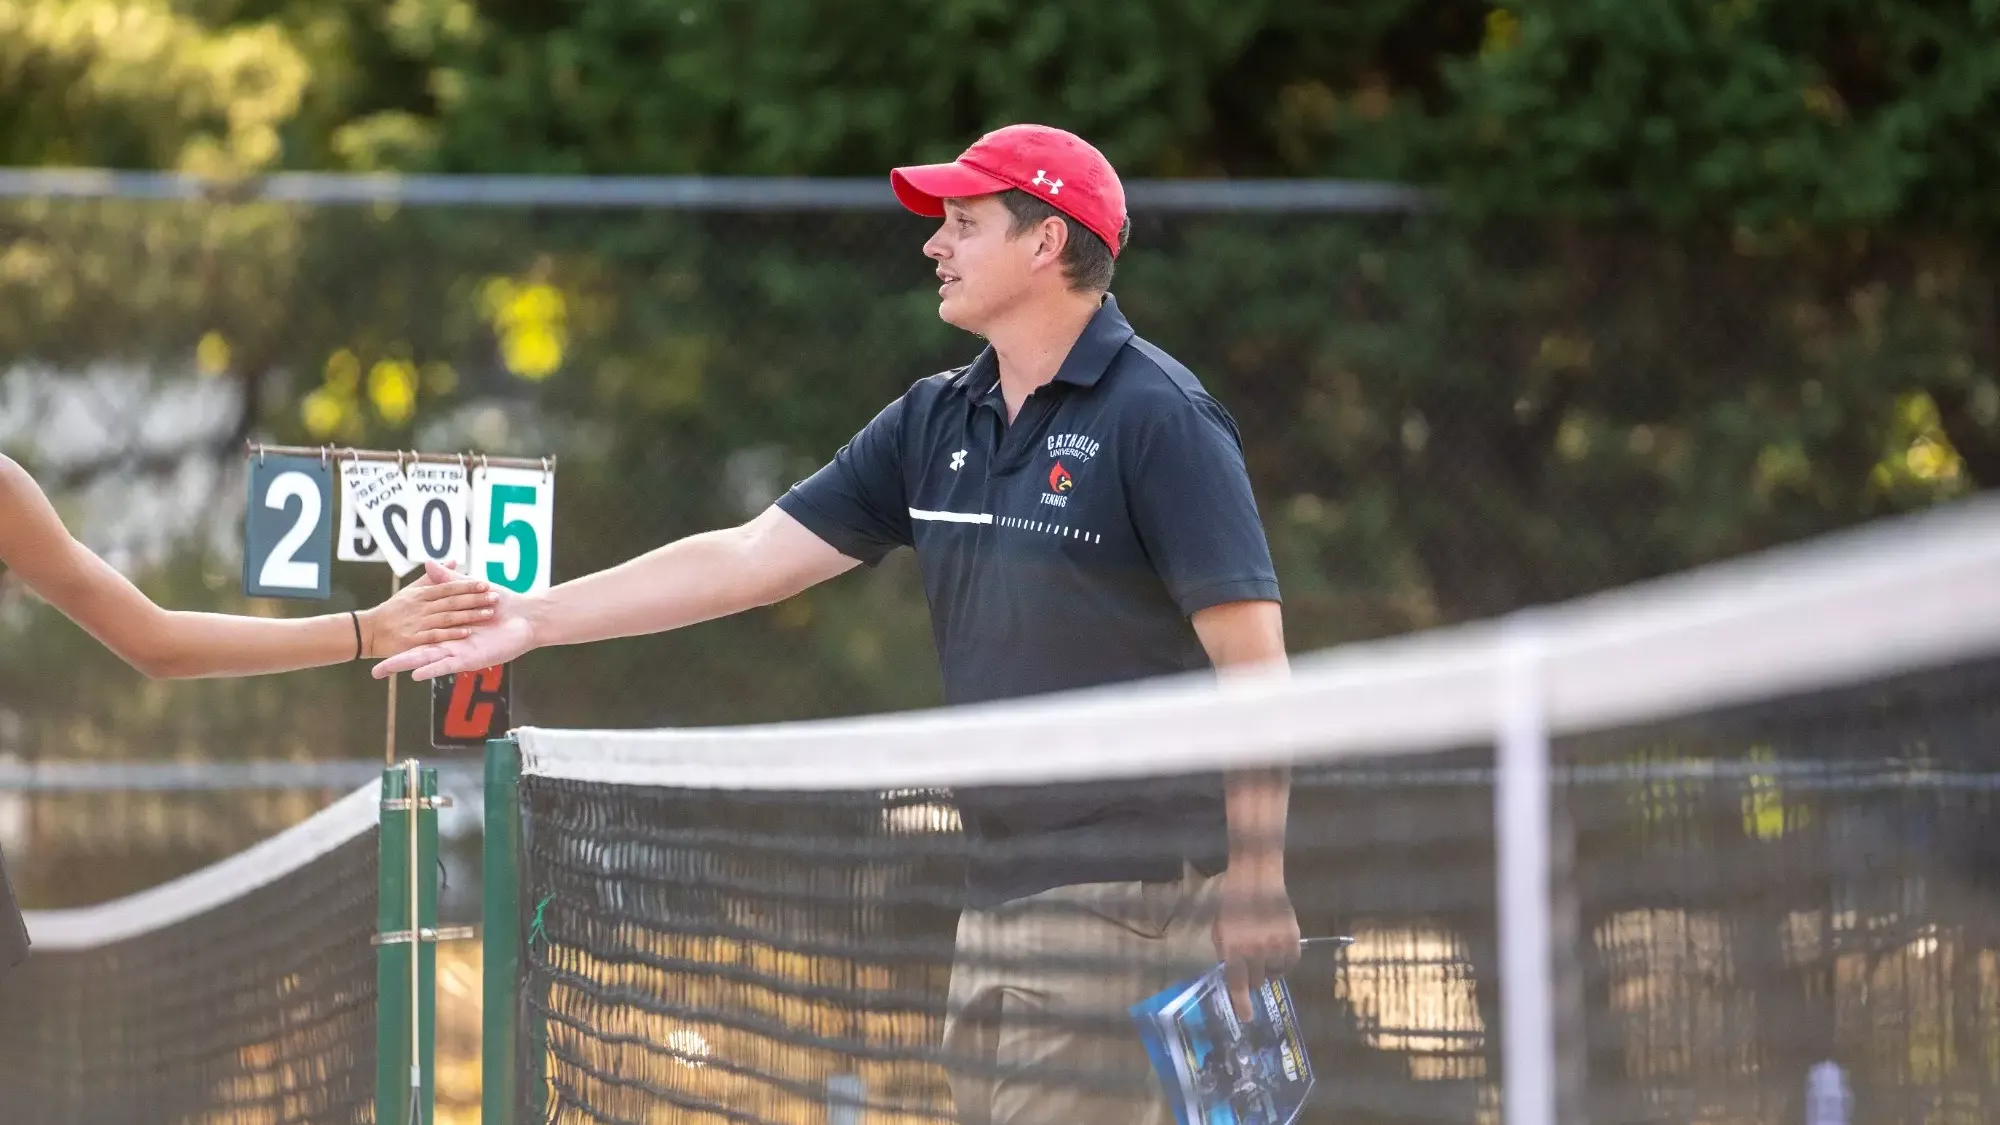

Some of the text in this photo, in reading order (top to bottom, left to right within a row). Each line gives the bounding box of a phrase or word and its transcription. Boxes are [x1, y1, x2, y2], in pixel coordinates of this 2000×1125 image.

[1047, 433, 1099, 457] CATHOLIC
[1050, 447, 1089, 463] UNIVERSITY
[416, 470, 460, 480] SETS
[365, 482, 402, 510] WON
[417, 483, 459, 494] WON
[1040, 492, 1068, 508] TENNIS
[258, 470, 321, 590] 2
[422, 498, 452, 559] 0
[486, 484, 539, 594] 5
[443, 664, 503, 738] C
